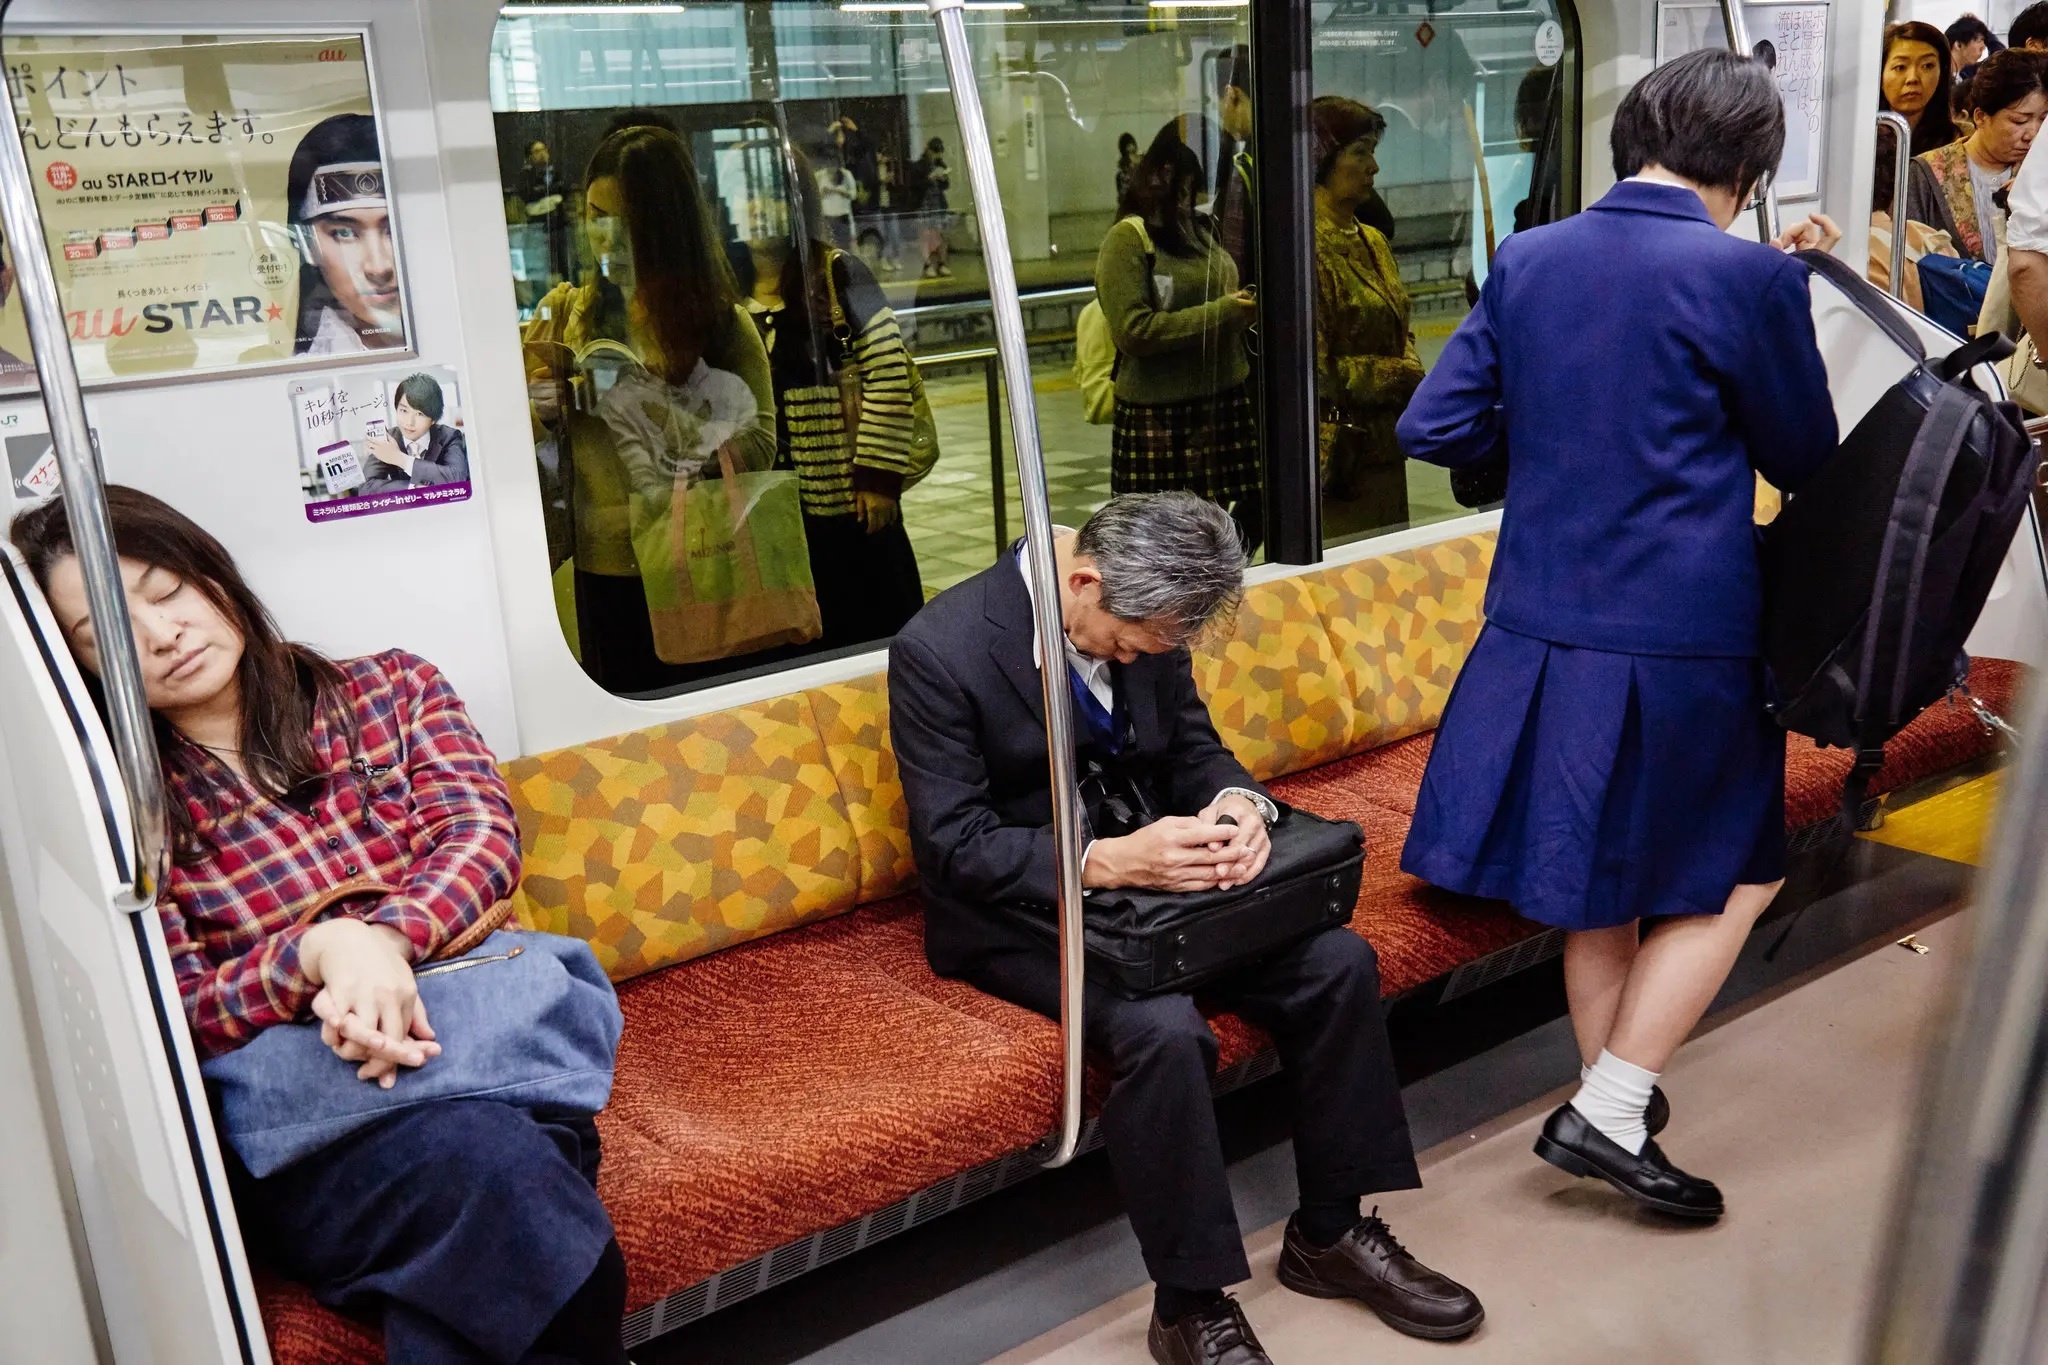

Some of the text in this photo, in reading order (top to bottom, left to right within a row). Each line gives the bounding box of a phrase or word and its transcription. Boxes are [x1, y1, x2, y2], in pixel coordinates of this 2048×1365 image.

[1788, 10, 1801, 92] ほとんど
[9, 62, 137, 99] ポイント
[19, 108, 274, 149] んどんもらえます。
[82, 168, 214, 191] au STARロイヤル
[142, 295, 264, 334] STAR
[304, 389, 349, 413] キレイを
[306, 393, 389, 430] 10秒チャージ。
[325, 462, 344, 477] in
